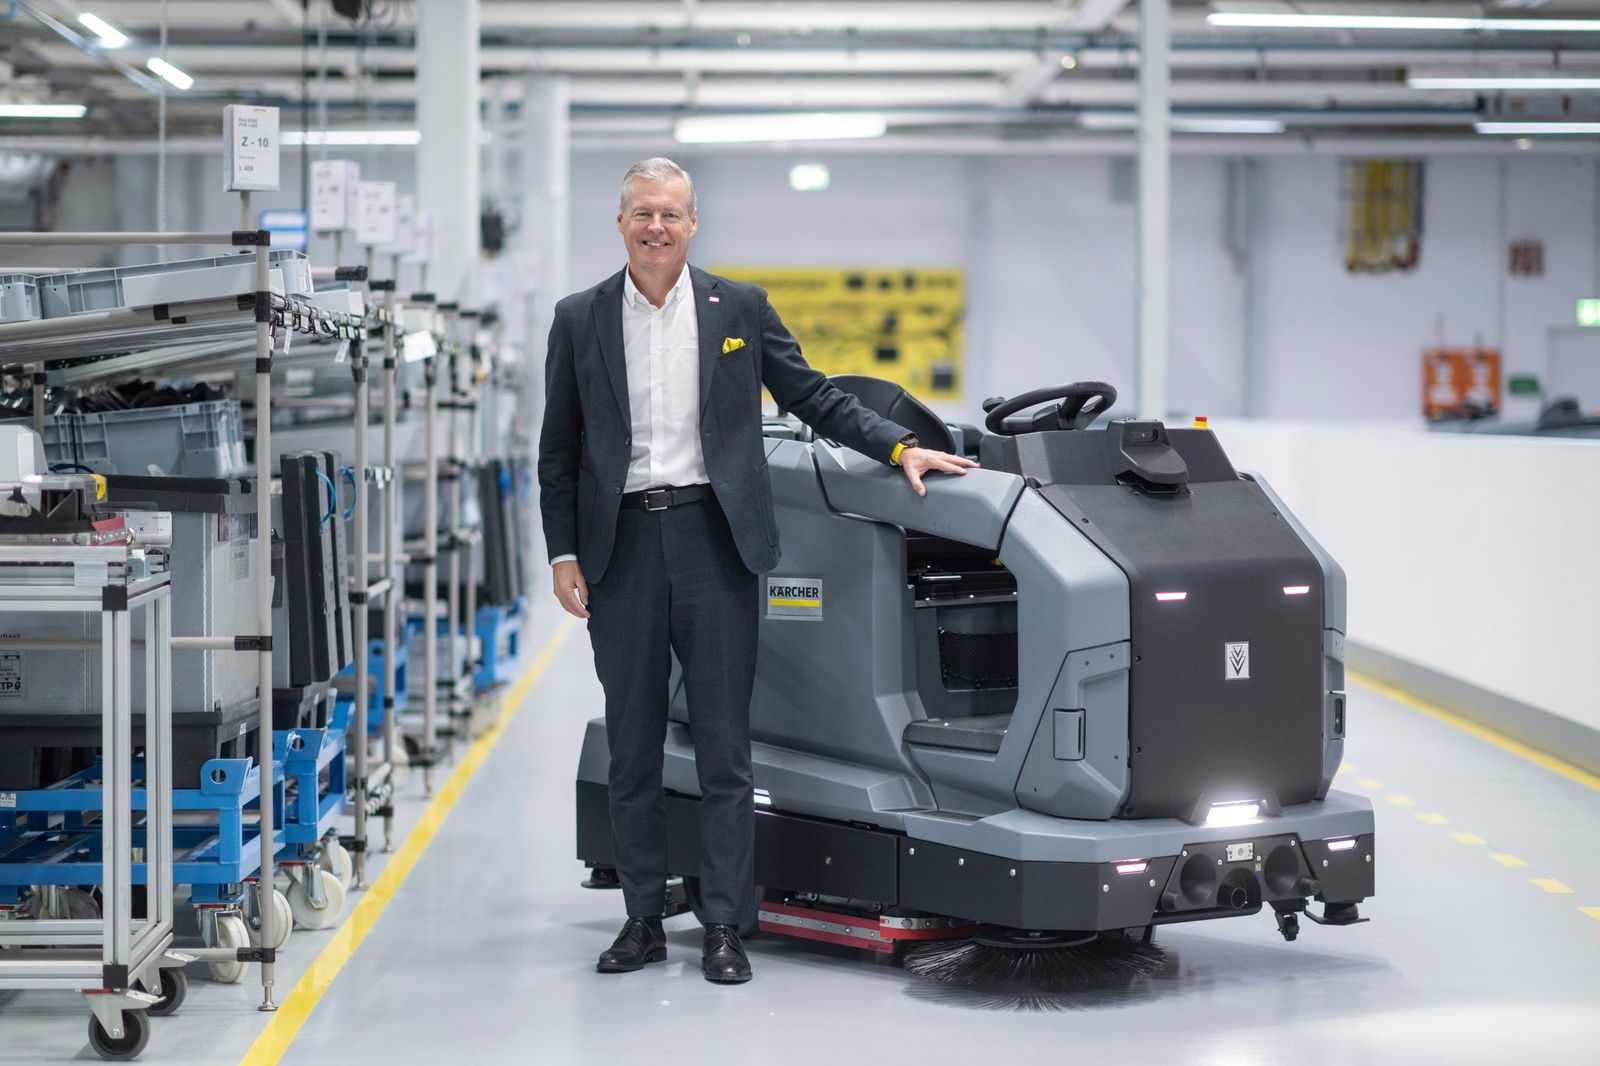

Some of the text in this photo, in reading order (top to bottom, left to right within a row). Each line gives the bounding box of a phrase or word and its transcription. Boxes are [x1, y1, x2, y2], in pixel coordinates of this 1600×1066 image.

[242, 136, 248, 147] Z
[257, 137, 269, 148] 10
[769, 585, 819, 598] KÄRCHER
